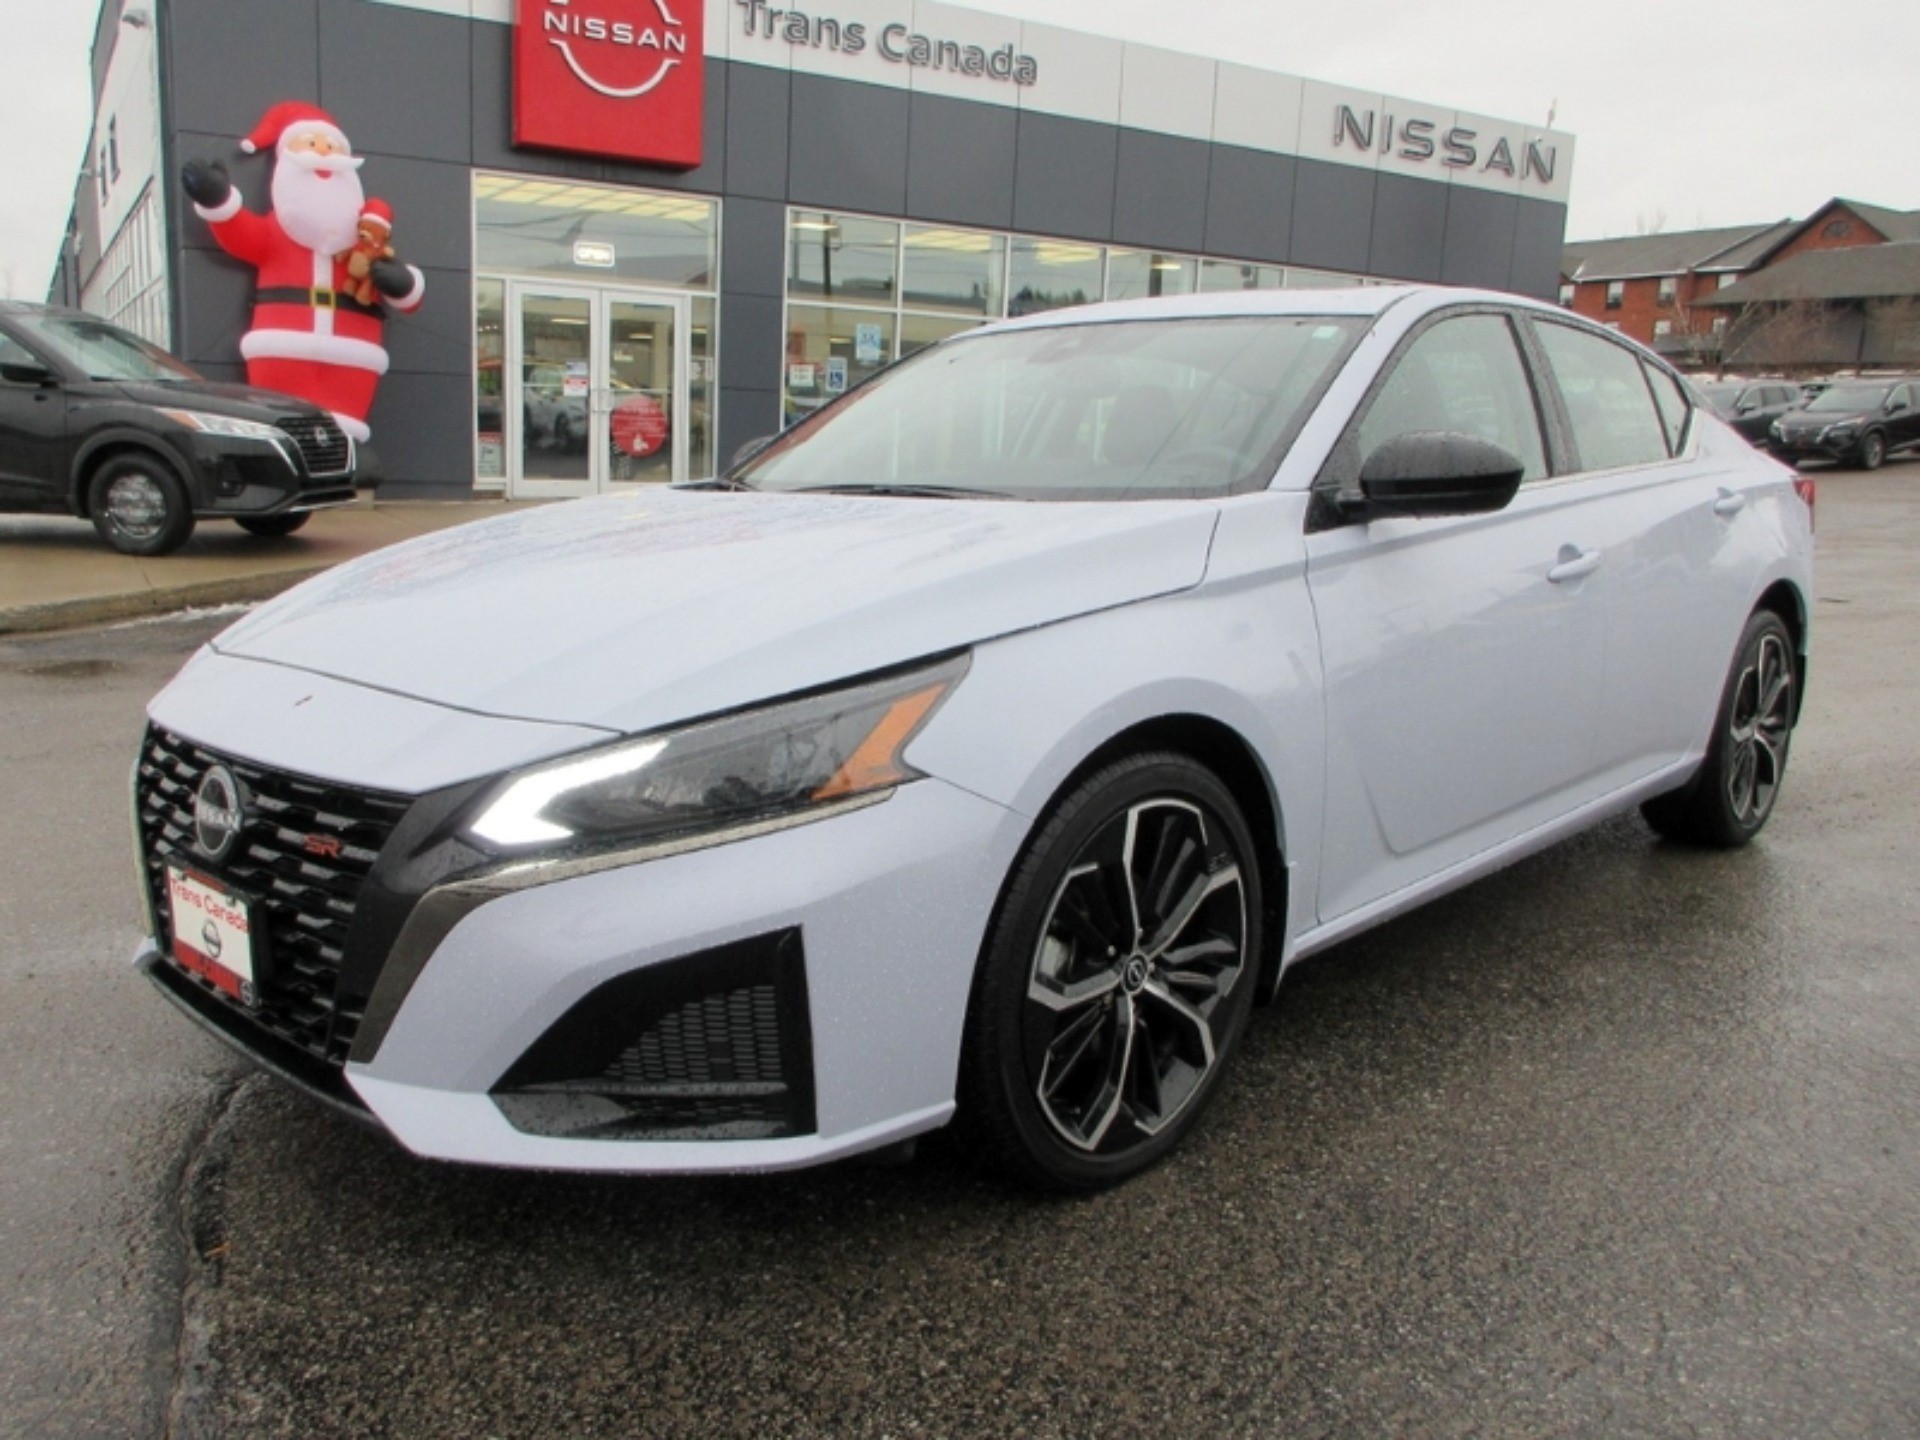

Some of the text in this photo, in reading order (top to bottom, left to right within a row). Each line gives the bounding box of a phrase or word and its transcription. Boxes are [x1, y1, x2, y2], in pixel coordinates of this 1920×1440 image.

[543, 9, 686, 54] NISSAN
[735, 0, 1039, 87] Trans Canada
[1333, 104, 1557, 184] NISSAN
[190, 794, 242, 833] SSAN
[304, 832, 341, 858] SR
[169, 877, 250, 933] Trans Canada
